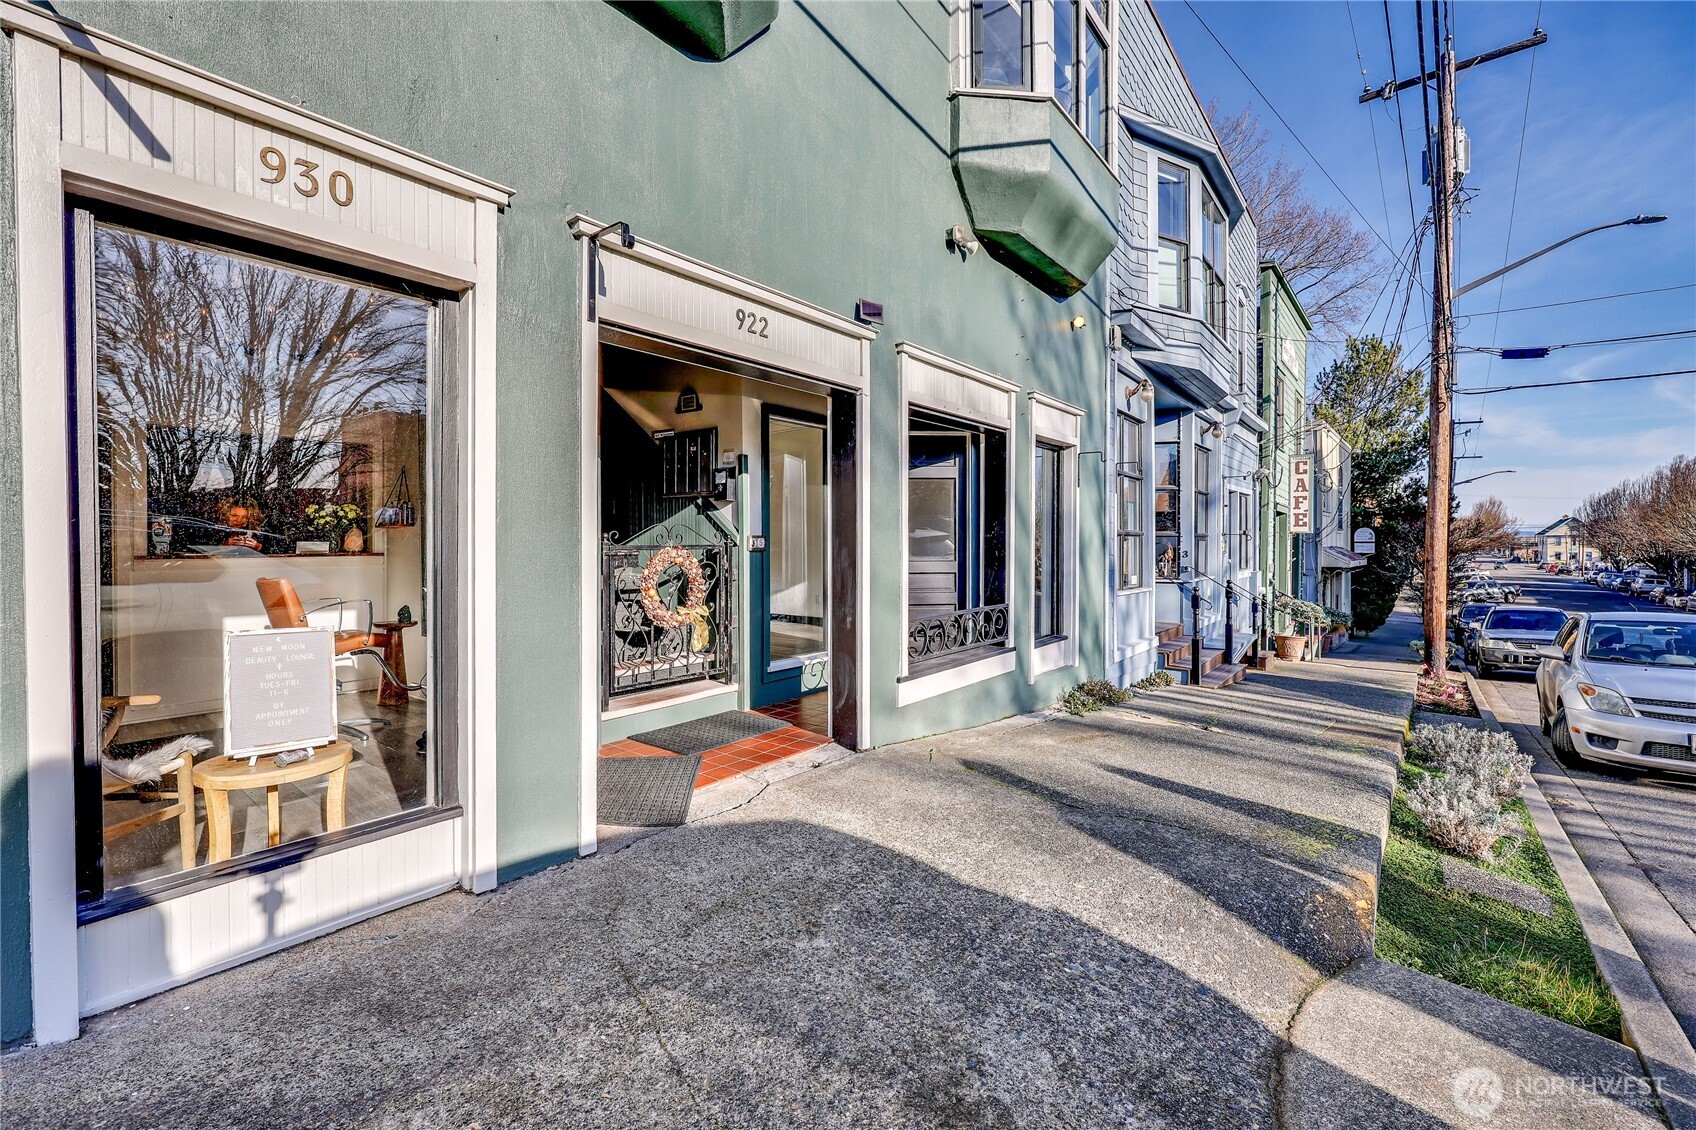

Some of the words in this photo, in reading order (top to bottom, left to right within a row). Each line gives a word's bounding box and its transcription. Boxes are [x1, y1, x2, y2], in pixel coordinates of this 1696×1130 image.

[260, 146, 354, 207] 930
[735, 308, 769, 339] 922
[1292, 460, 1309, 527] CAFÉ
[1181, 550, 1189, 558] 3
[252, 645, 273, 653] NEW
[280, 643, 306, 651] MOON
[245, 655, 277, 665] BEAUTY
[286, 652, 315, 661] LOUNGE
[265, 671, 294, 680] HOURS
[259, 680, 300, 689] TUES-FRI
[273, 701, 284, 709] BY
[255, 707, 310, 720] APPOINTMENT
[267, 718, 293, 727] ONLY
